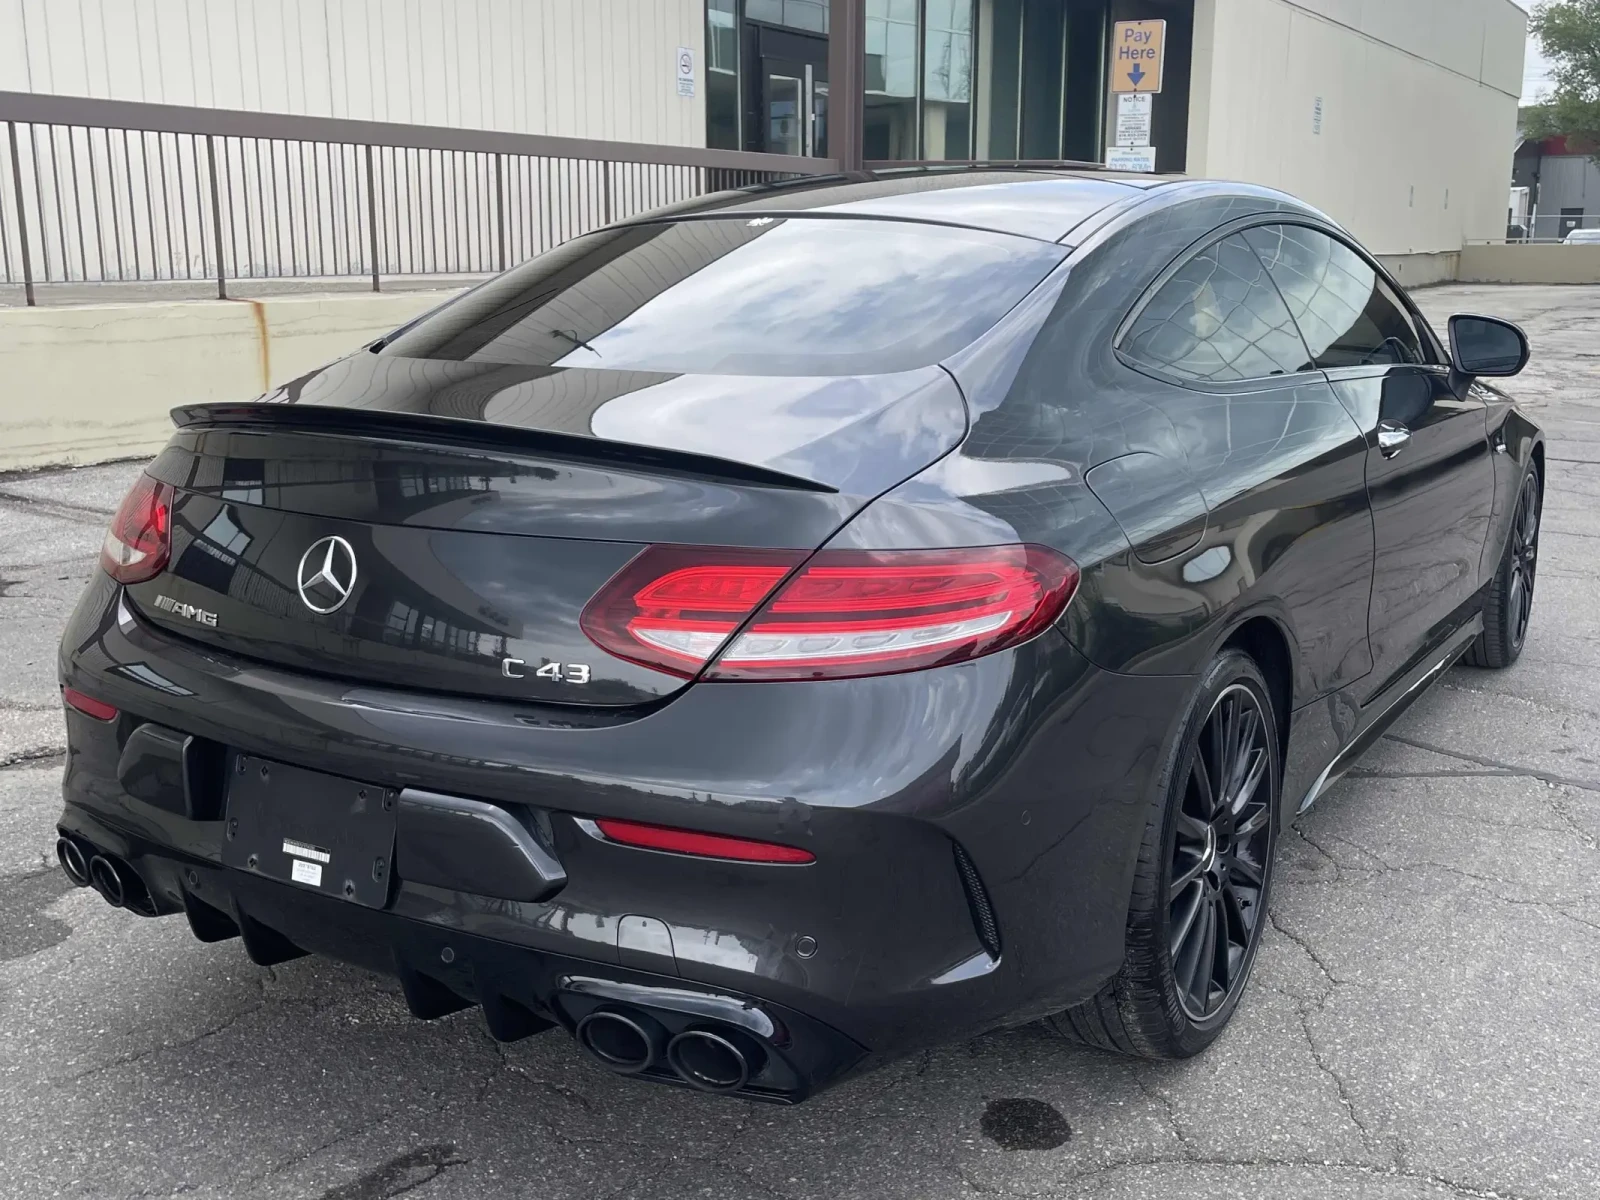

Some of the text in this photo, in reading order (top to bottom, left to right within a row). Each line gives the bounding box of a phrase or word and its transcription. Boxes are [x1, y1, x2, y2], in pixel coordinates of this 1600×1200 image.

[1124, 28, 1152, 45] Pay
[1119, 46, 1156, 60] Here
[501, 658, 590, 684] C 43
